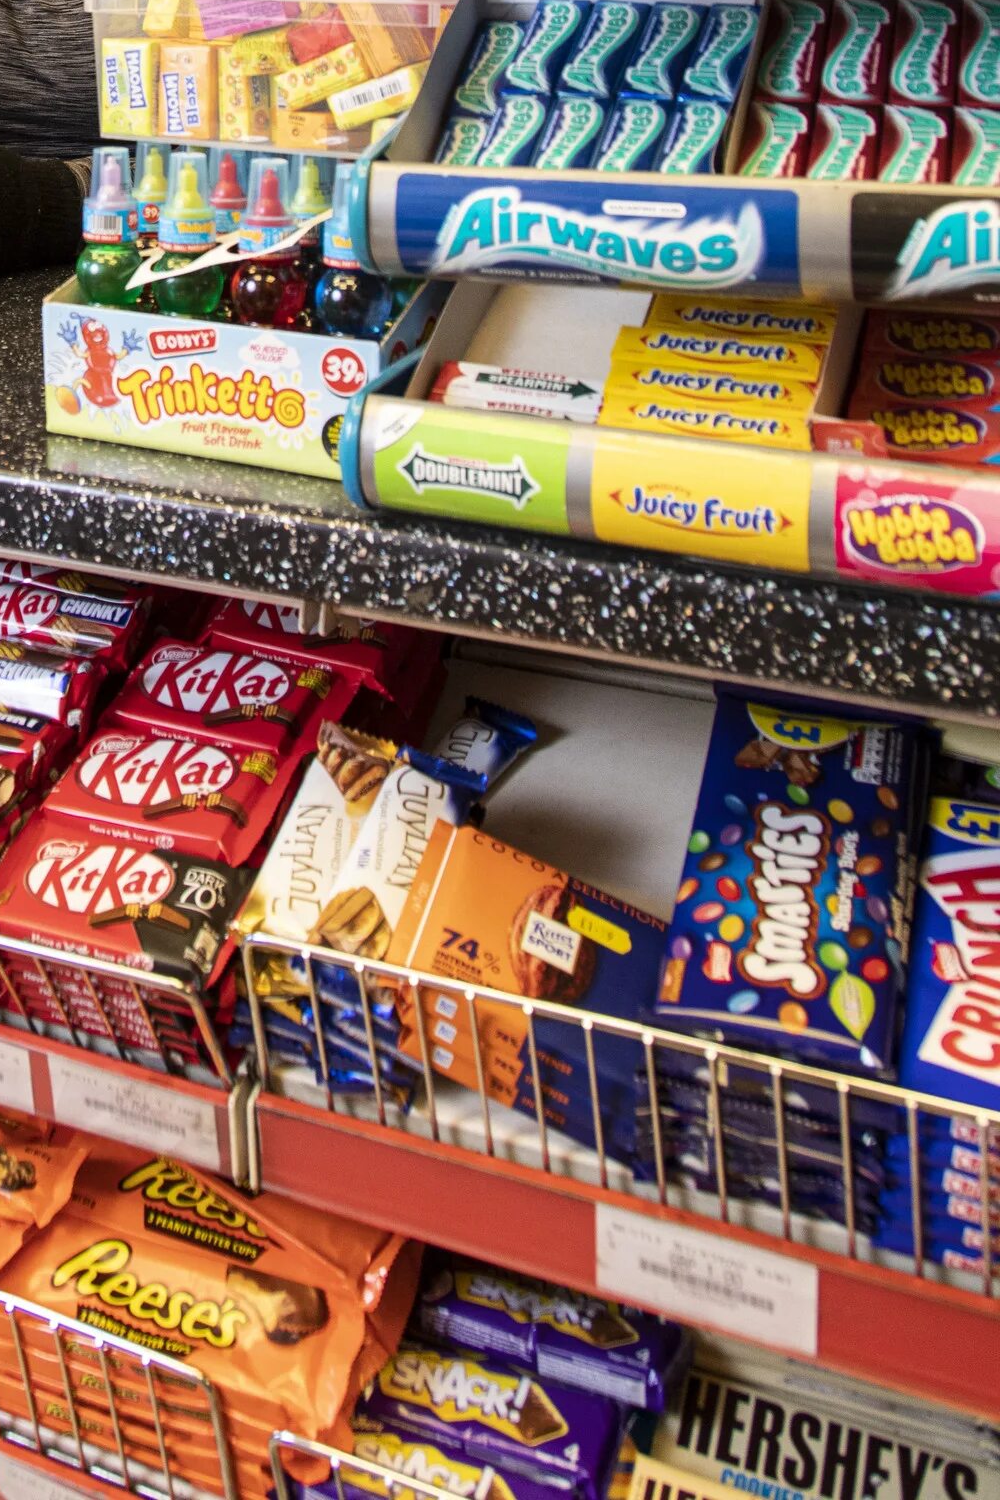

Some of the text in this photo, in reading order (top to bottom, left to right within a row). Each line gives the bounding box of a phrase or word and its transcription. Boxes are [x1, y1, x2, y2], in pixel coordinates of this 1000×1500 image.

[168, 74, 180, 133] MAOAM
[448, 188, 740, 273] Airwaves
[153, 331, 364, 384] BOBBY'S 39p
[118, 366, 305, 427] Trinketto
[488, 374, 571, 393] SPEARMINT
[182, 422, 252, 437] Fruit Flavour
[204, 437, 262, 449] Soft Drink
[414, 457, 530, 499] DOUBLEMINT
[627, 493, 777, 534] Juicy Fruit
[851, 505, 946, 544] Hubba
[876, 536, 977, 565] Bubba
[61, 599, 128, 623] CHUNKY
[88, 739, 236, 802] KitKat
[186, 870, 225, 886] DARK
[473, 834, 666, 930] COCOA SELECTION
[442, 928, 479, 958] 74
[527, 935, 572, 962] SPORT
[56, 1239, 245, 1348] Reese's
[393, 1352, 532, 1423] SNACK!
[677, 1373, 978, 1499] HERSHEY'S
